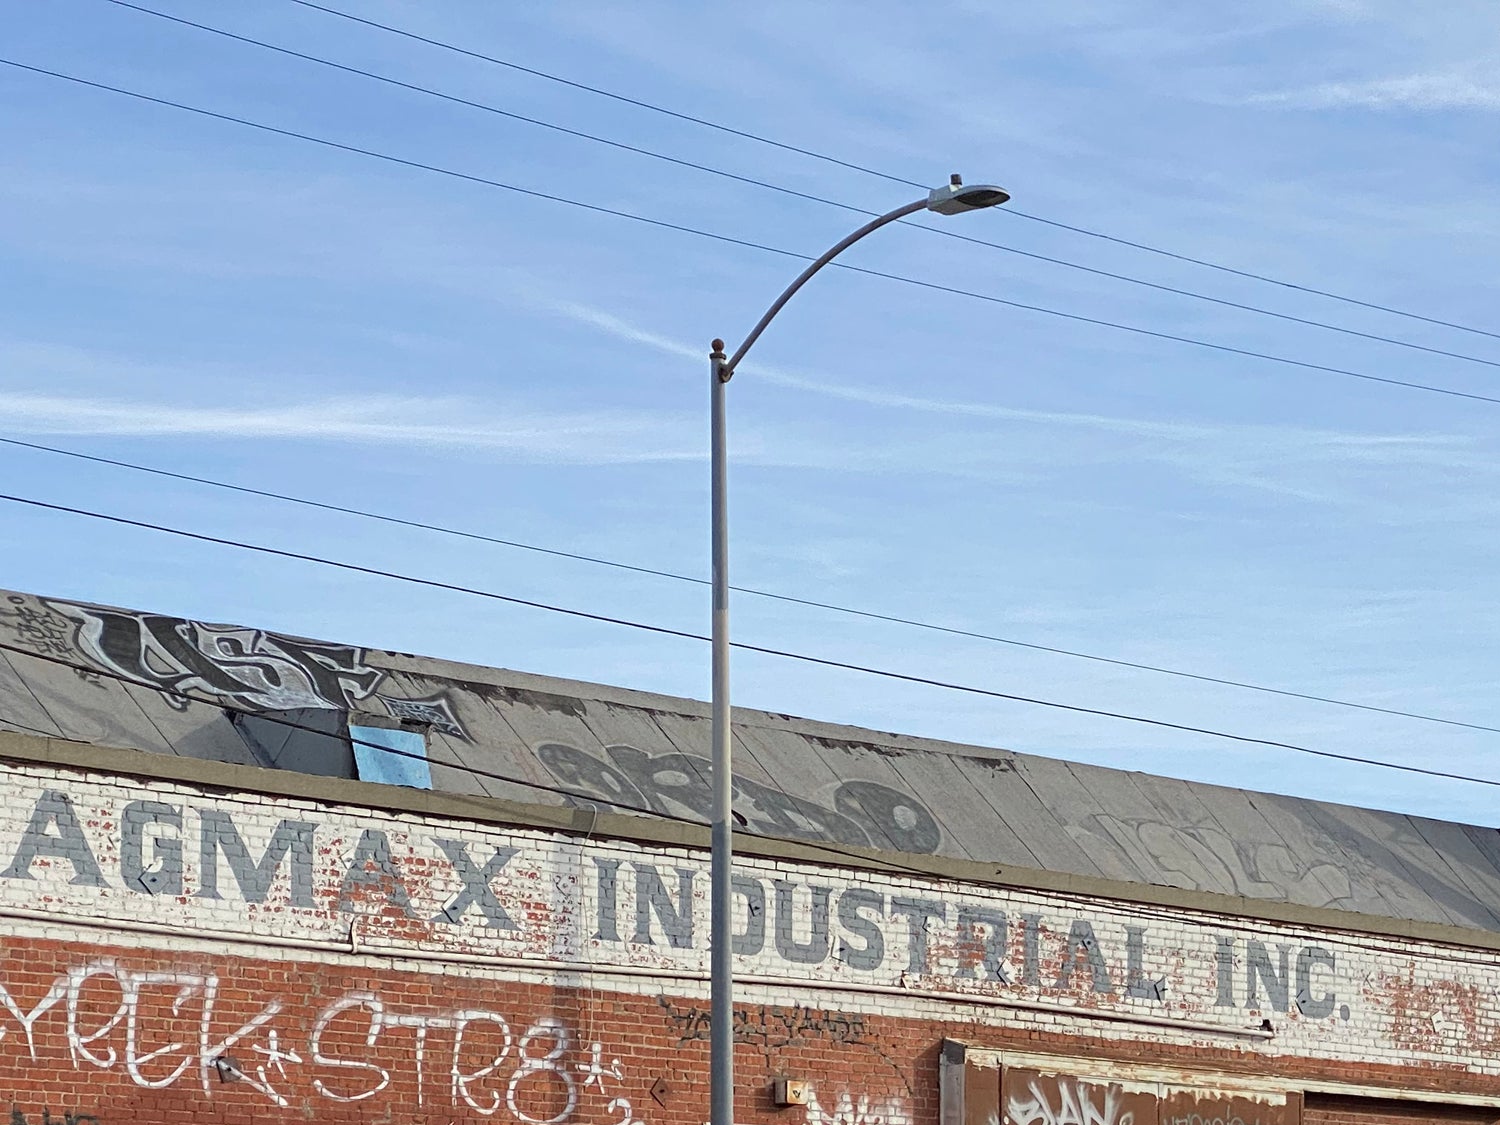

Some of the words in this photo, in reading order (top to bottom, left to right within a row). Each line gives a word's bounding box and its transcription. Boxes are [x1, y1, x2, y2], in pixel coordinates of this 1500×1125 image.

[1, 789, 522, 932] AGMAX
[590, 856, 1168, 1002] INDUSTRIAL
[1213, 936, 1351, 1021] INC.
